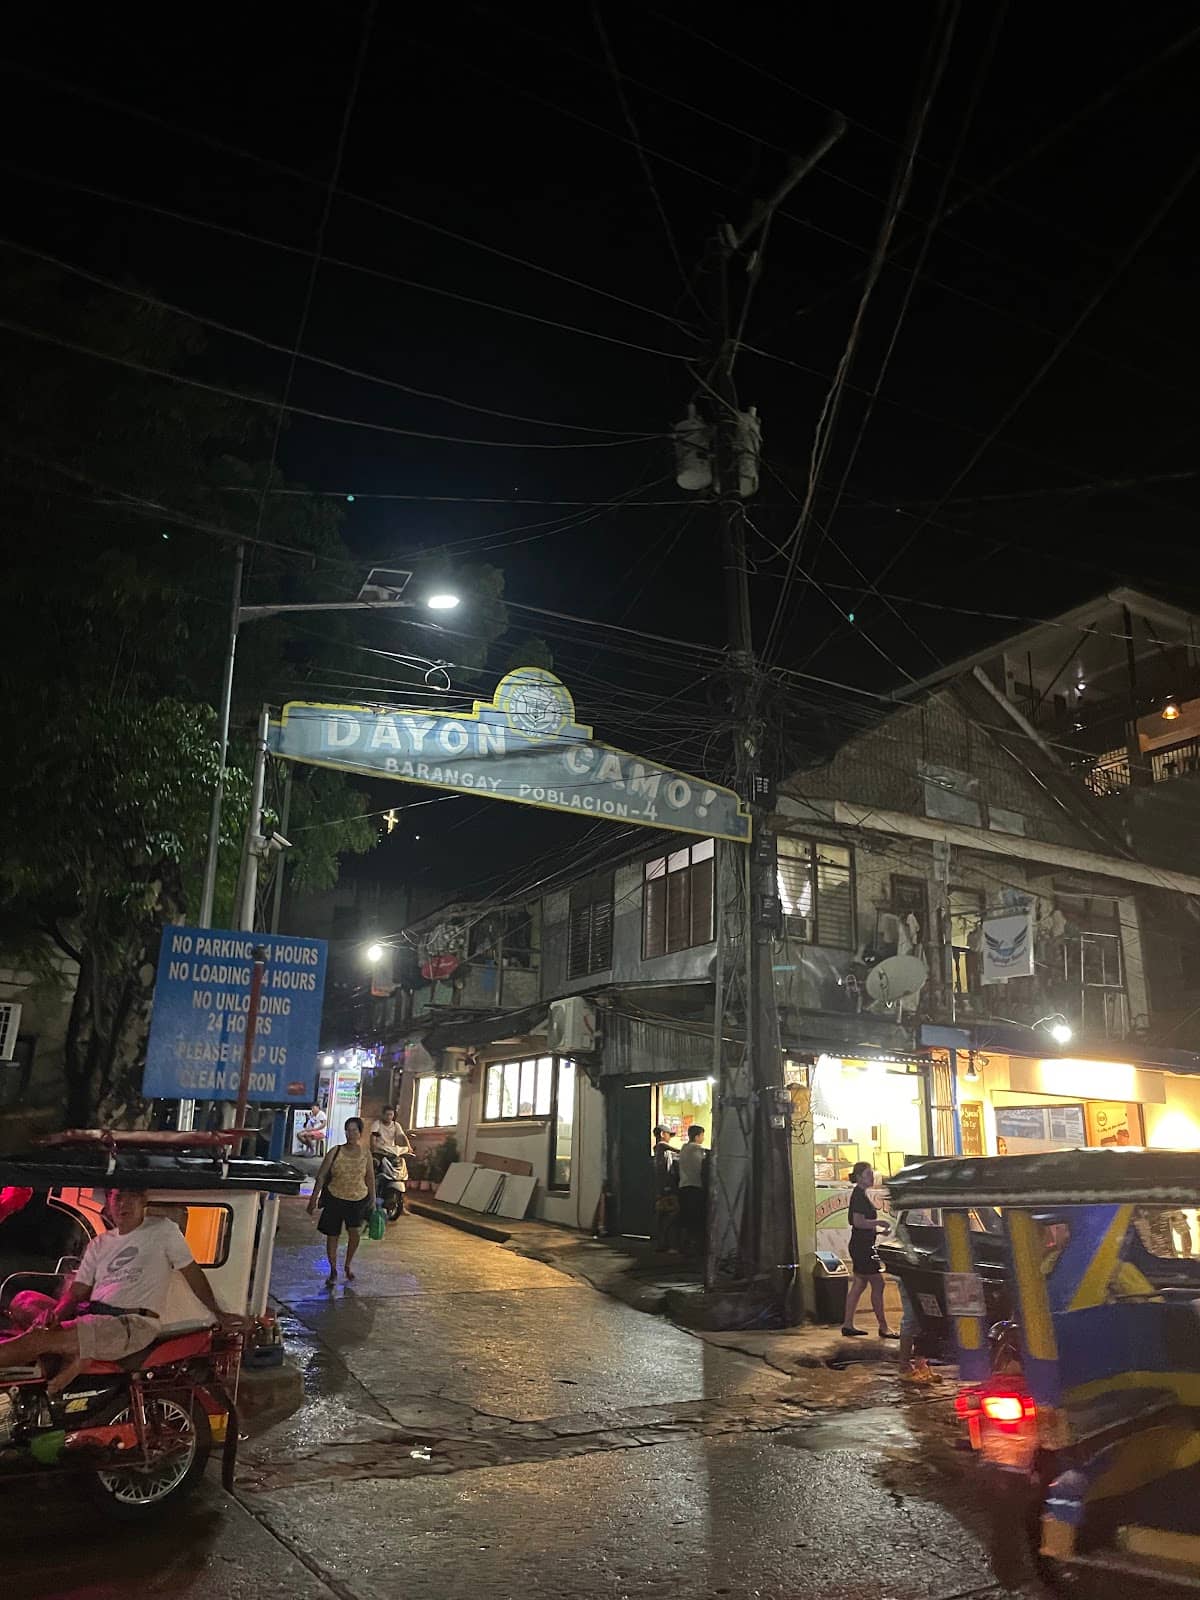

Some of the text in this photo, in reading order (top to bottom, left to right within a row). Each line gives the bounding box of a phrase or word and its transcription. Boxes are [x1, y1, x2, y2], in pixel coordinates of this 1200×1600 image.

[327, 714, 717, 818] DAYON CAMO!
[384, 758, 503, 792] BARANGAY
[172, 935, 192, 953] NO
[195, 937, 253, 960] PARKING
[275, 945, 319, 966] HOURS
[169, 961, 189, 980] NO
[192, 963, 251, 986] LOADING
[272, 970, 316, 992] HOURS
[193, 990, 291, 1016] NO UNLODING
[207, 1012, 273, 1035] 24 HORS
[177, 1040, 288, 1065] PLEASE HLP US
[230, 1071, 276, 1093] CRON
